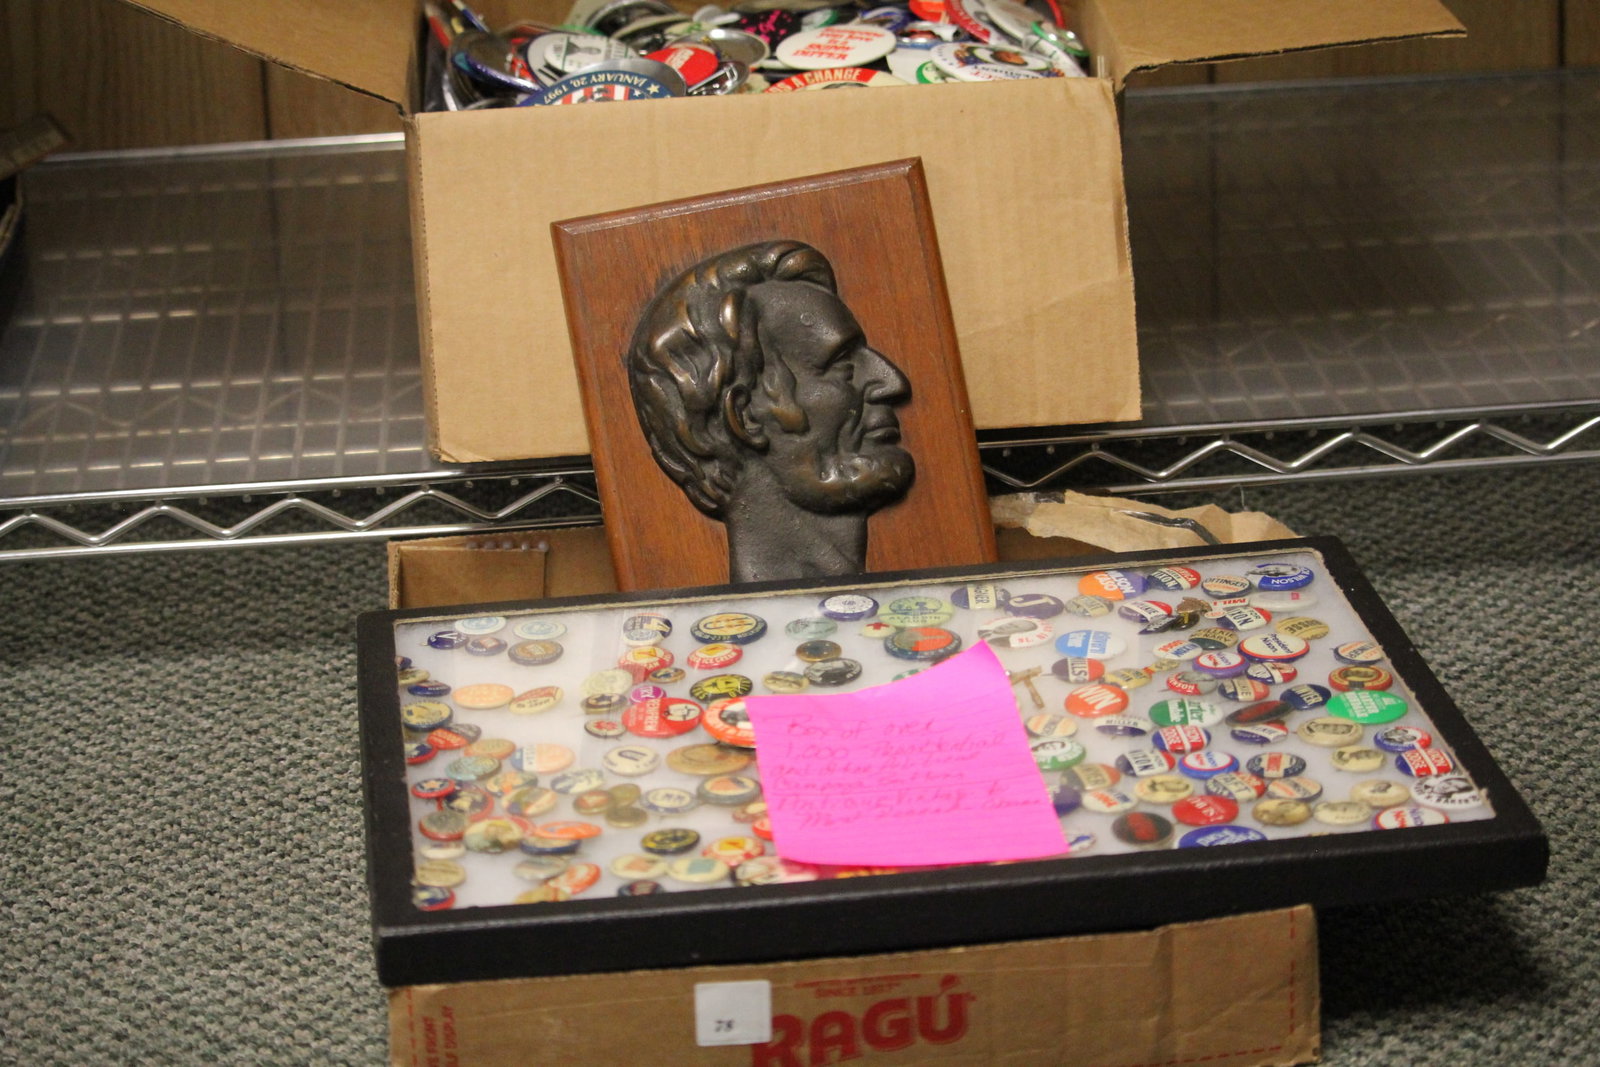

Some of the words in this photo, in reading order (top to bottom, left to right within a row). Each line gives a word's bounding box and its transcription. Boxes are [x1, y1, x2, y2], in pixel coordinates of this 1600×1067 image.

[570, 77, 588, 88] 20,
[590, 73, 648, 87] JANUARY
[793, 75, 805, 89] A
[804, 68, 862, 86] CHANGE
[543, 84, 569, 104] 1997
[1094, 573, 1118, 591] CASO
[1152, 571, 1178, 588] NIXON
[1271, 574, 1308, 584] WILSON
[1268, 633, 1294, 654] President
[1072, 684, 1122, 710] WIN
[1106, 719, 1139, 727] MILLER
[1404, 751, 1427, 769] LODGE
